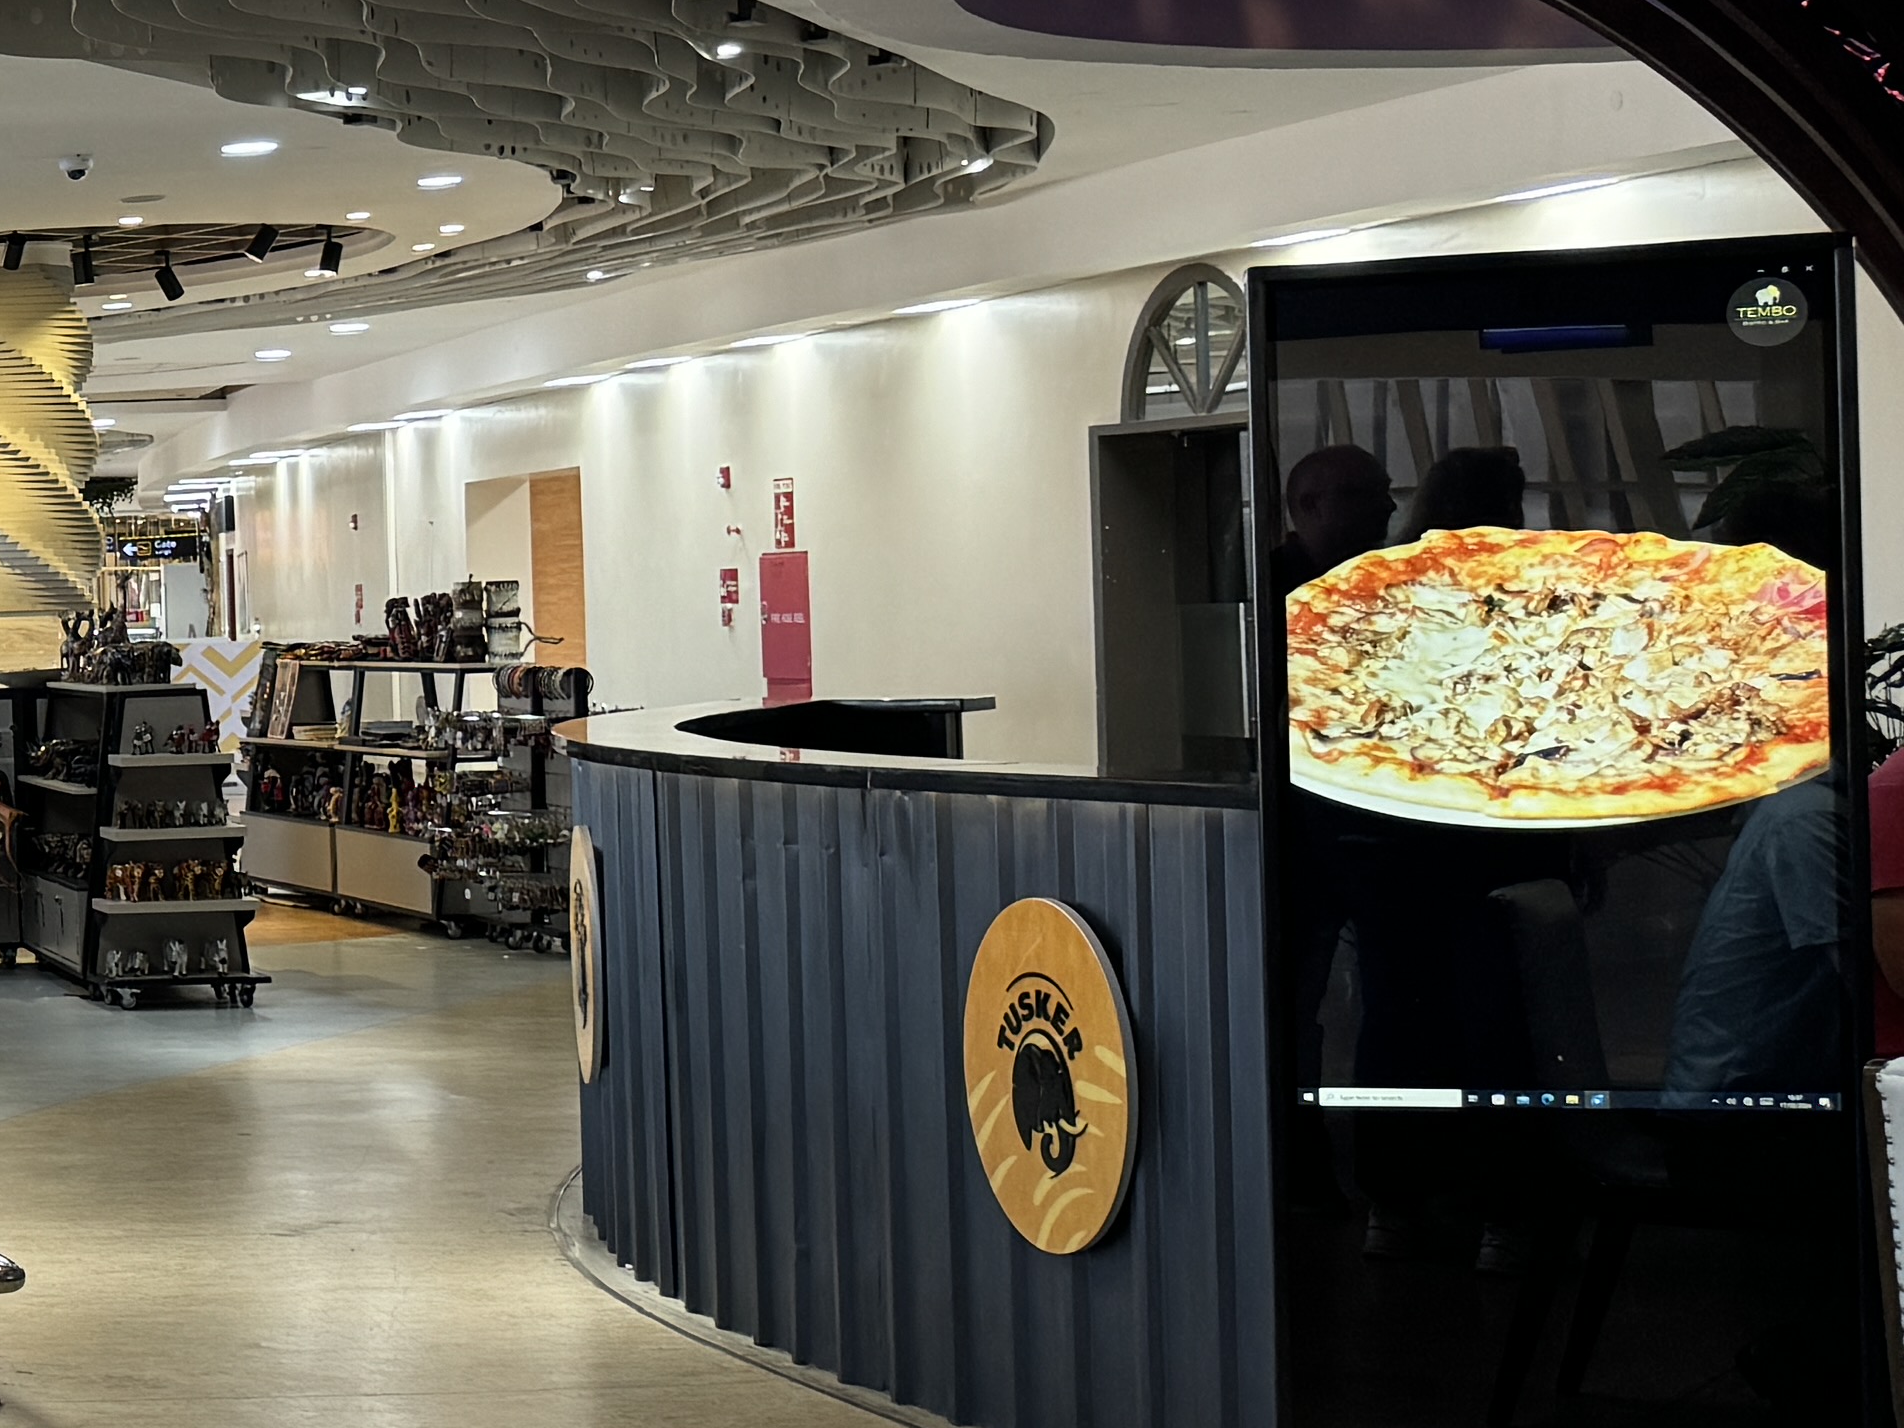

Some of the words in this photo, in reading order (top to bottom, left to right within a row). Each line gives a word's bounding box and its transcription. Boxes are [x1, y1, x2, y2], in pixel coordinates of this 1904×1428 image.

[1735, 305, 1797, 318] TEMBO
[154, 539, 177, 549] Gate
[996, 989, 1084, 1061] TUSKER
